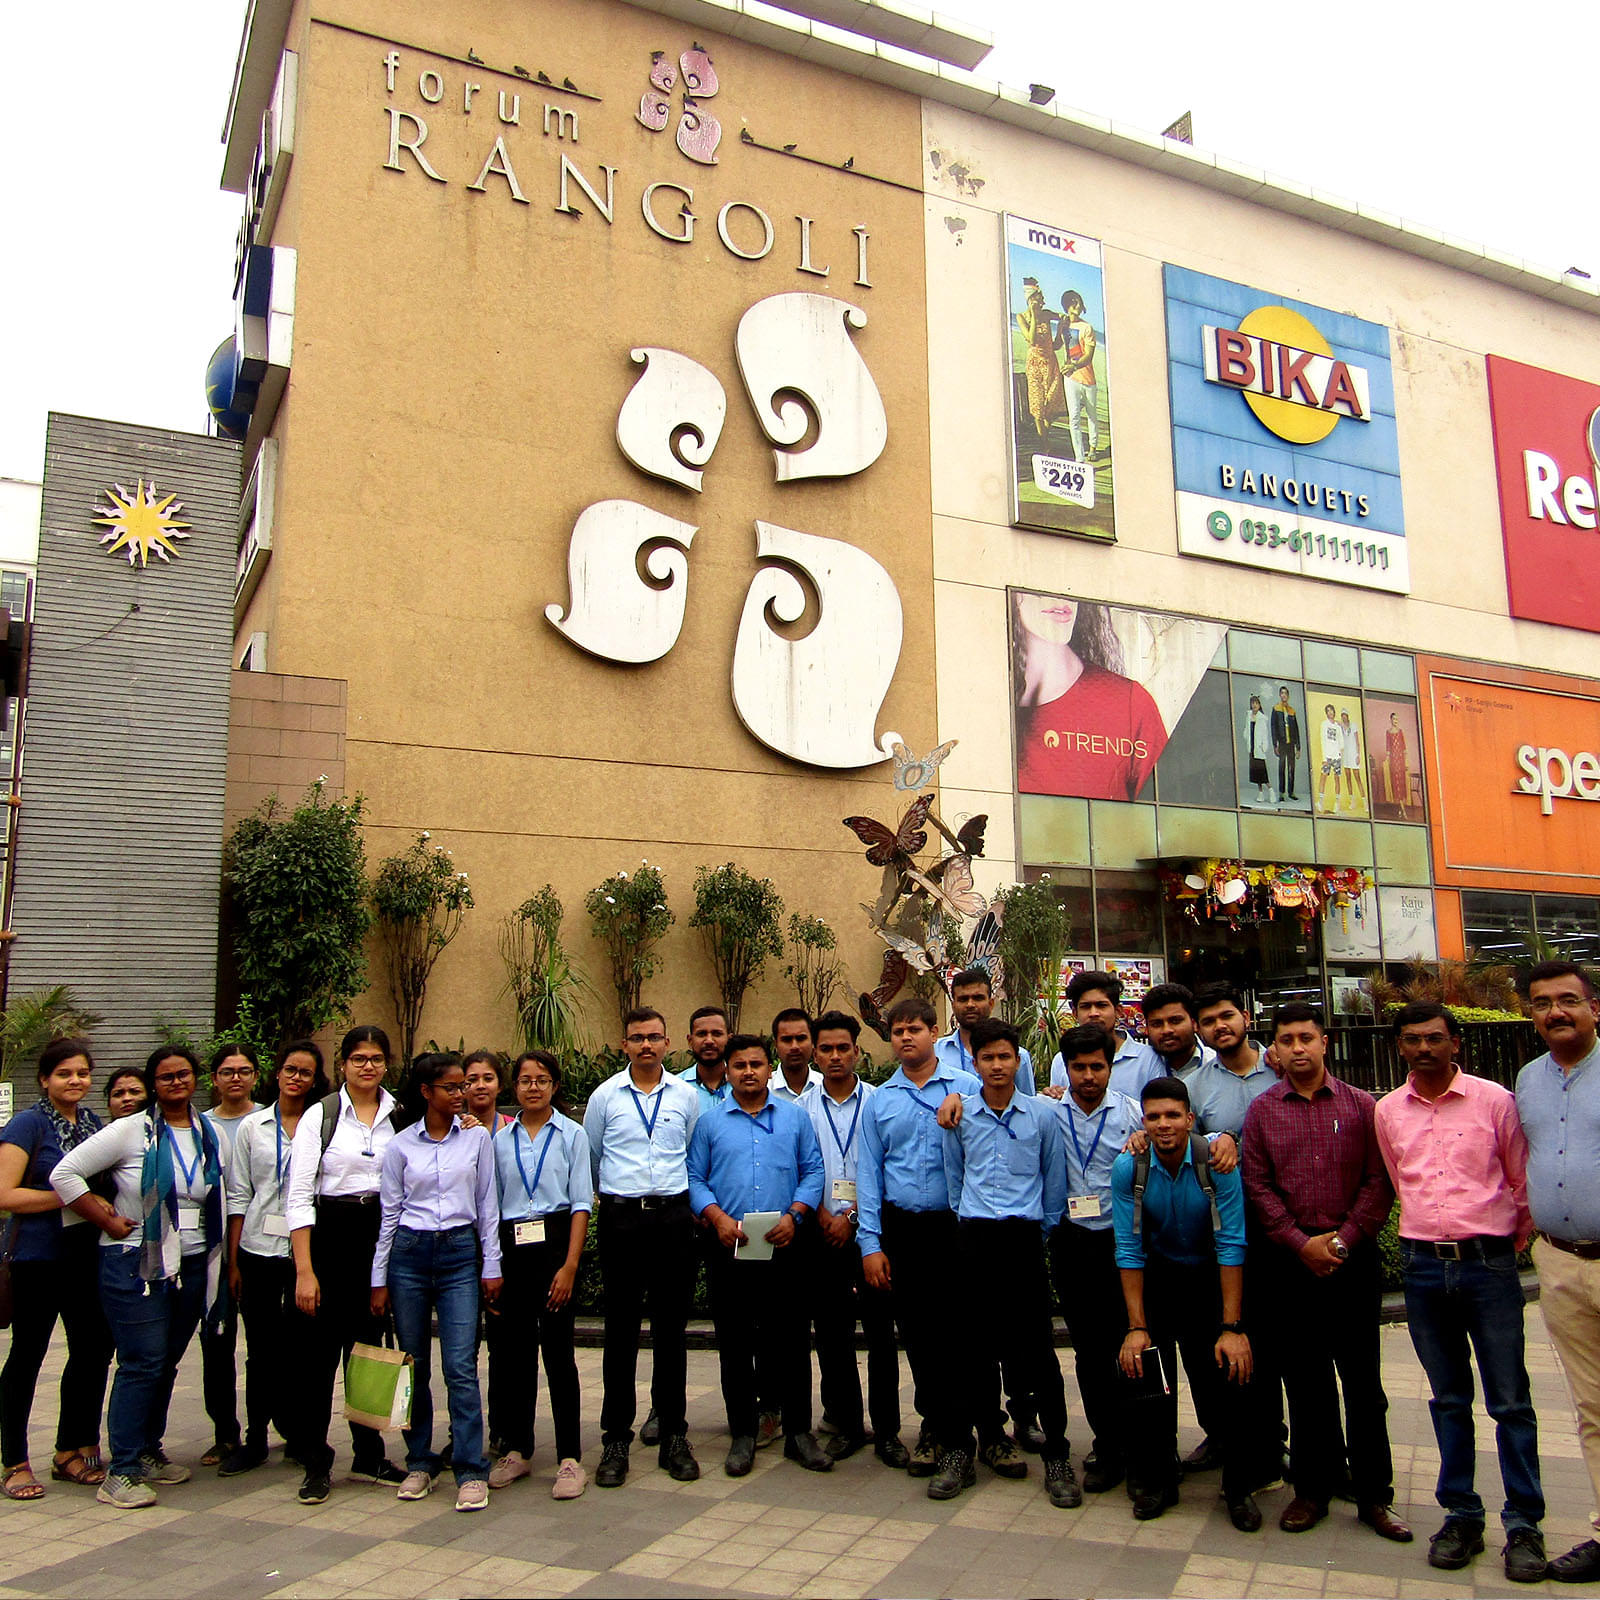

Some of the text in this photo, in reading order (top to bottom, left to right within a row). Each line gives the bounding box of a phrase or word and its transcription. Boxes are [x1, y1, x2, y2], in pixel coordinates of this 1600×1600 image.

[383, 51, 580, 143] forum
[383, 106, 873, 289] RANGOLI
[1028, 228, 1076, 254] max
[1214, 327, 1363, 418] BIKA
[1041, 460, 1086, 473] YOUTH STYLES
[1220, 463, 1371, 518] BANQUETS
[1061, 731, 1148, 759] TRENDS
[1401, 895, 1424, 910] Kaju
